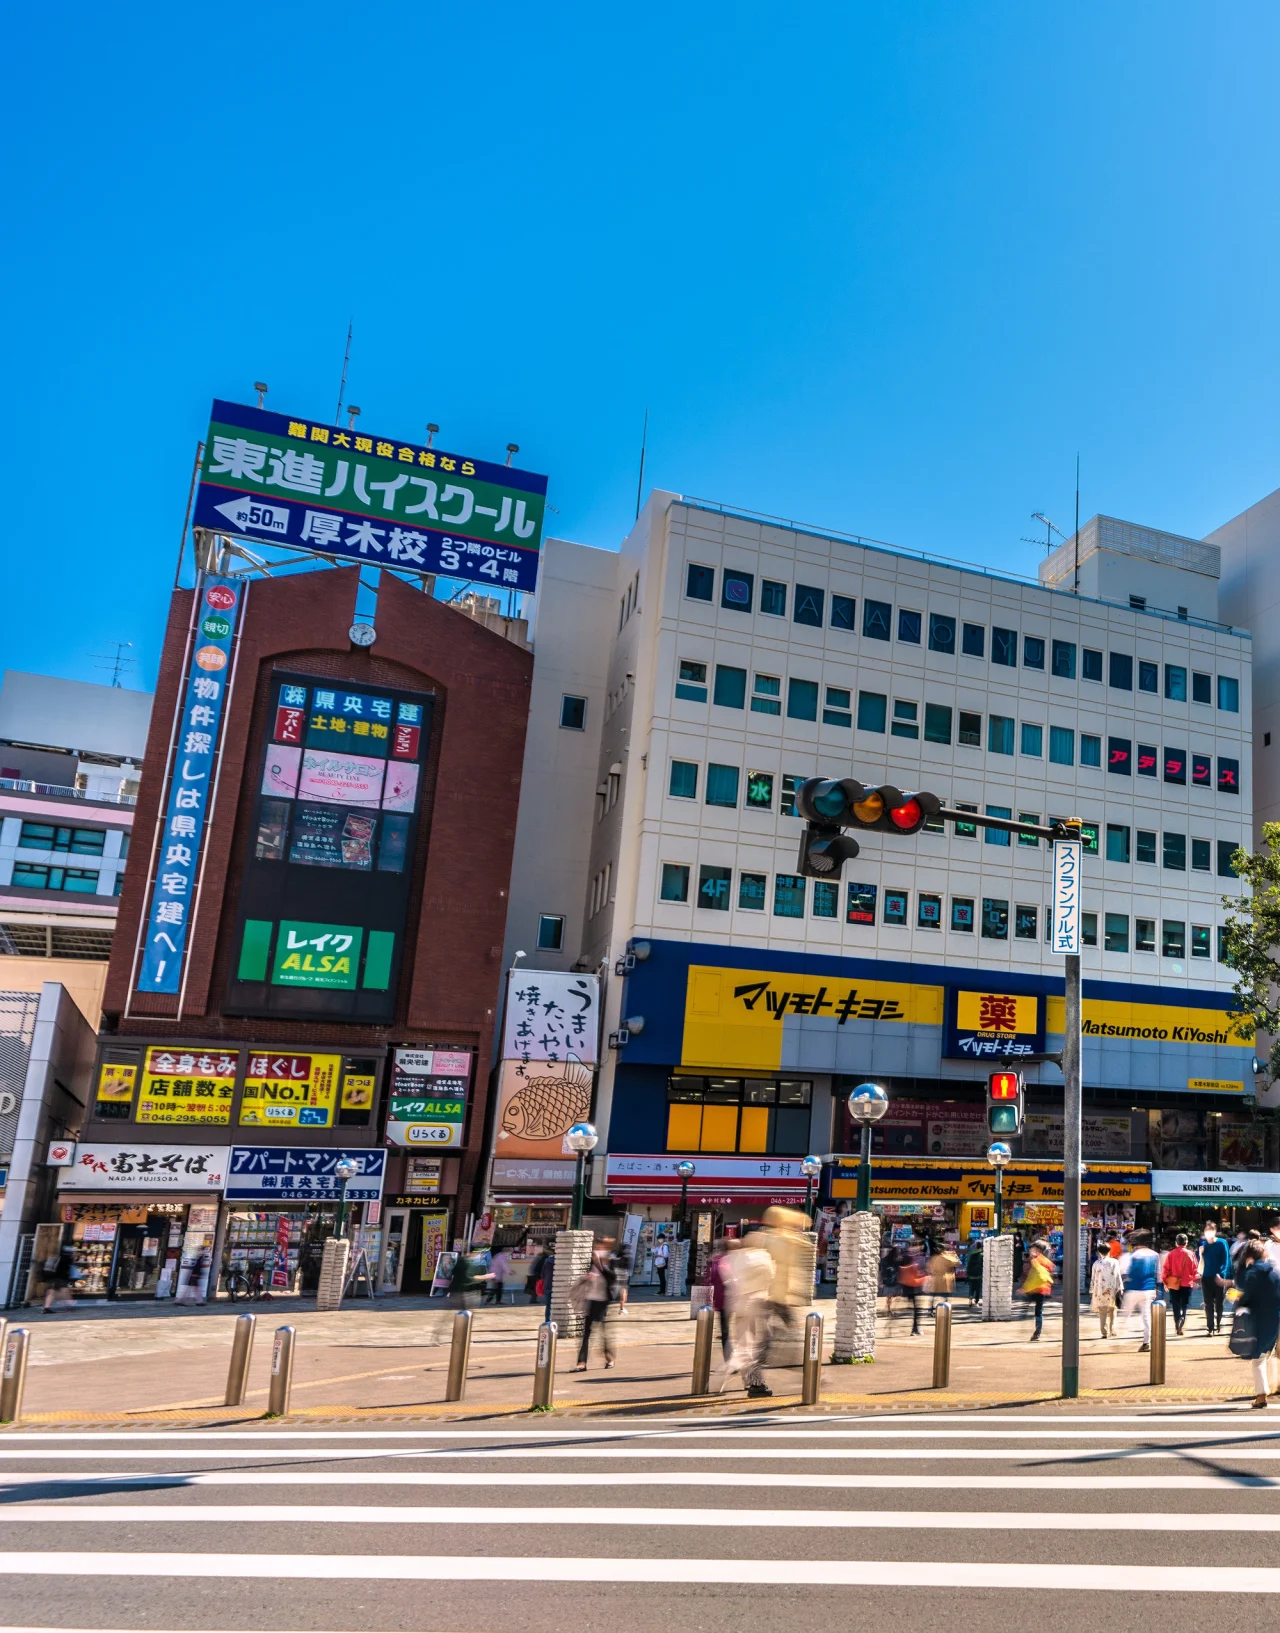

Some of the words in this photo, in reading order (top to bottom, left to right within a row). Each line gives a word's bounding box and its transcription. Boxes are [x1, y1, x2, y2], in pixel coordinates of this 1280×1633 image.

[288, 421, 477, 476] 難関大現役合格なら
[208, 435, 536, 539] 東進ハイスクール
[236, 502, 286, 531] 約50m
[300, 508, 429, 566] 厚木校
[441, 537, 523, 564] 2つ隣のビル
[438, 552, 519, 584] 3・4階
[209, 592, 233, 605] 安心
[204, 621, 229, 635] 親切
[767, 583, 954, 645] TAKANO
[996, 633, 1091, 672] YURI
[1143, 663, 1185, 692] 7F
[315, 690, 418, 722] 県央宅建
[283, 709, 300, 739] アパート
[311, 714, 389, 739] 土地・建物
[396, 726, 412, 753] マンション
[303, 756, 384, 777] ネイルサロン
[1109, 749, 1236, 787] アデランス
[749, 780, 772, 802] 水
[701, 878, 729, 898] 4F
[777, 876, 795, 888] 中野
[816, 883, 830, 892] TEL
[848, 883, 877, 896] ロレアル
[776, 890, 793, 901] 法律
[1058, 846, 1075, 949] スクランブル式
[775, 904, 801, 917] 事務所
[889, 900, 970, 921] 美容室
[287, 930, 353, 953] レイク
[281, 953, 350, 974] ALSA
[733, 980, 905, 1026] マツモトキヨシ
[979, 995, 1017, 1031] 薬
[566, 980, 592, 1049] うまい
[514, 985, 541, 1081] 焼きあげます。
[538, 1000, 565, 1069] たいやき
[976, 1031, 996, 1039] DRUG
[996, 1033, 1017, 1041] STORE
[1080, 1019, 1168, 1040] Matsumoto
[1172, 1026, 1229, 1045] KiYoshi
[958, 1036, 1034, 1056] マツモトキヨシ
[399, 1058, 428, 1068] 県央宅建
[151, 1113, 227, 1123] 046-295-5055
[268, 1107, 294, 1117] りらくる
[412, 1130, 446, 1140] りらくる
[77, 1153, 109, 1173] 名代
[111, 1152, 214, 1174] 富士そば
[232, 1150, 384, 1174] アパート・マンョン
[759, 1161, 806, 1177] 中村
[494, 1168, 540, 1179] 一口茶屋
[868, 1183, 919, 1195] atsumoto
[920, 1184, 959, 1195] KiYoshi
[1042, 1187, 1096, 1197] Matsoto
[1097, 1187, 1131, 1198] KiYoshi
[1183, 1184, 1220, 1192] KOMESHIN
[396, 1197, 439, 1205] カネカビル
